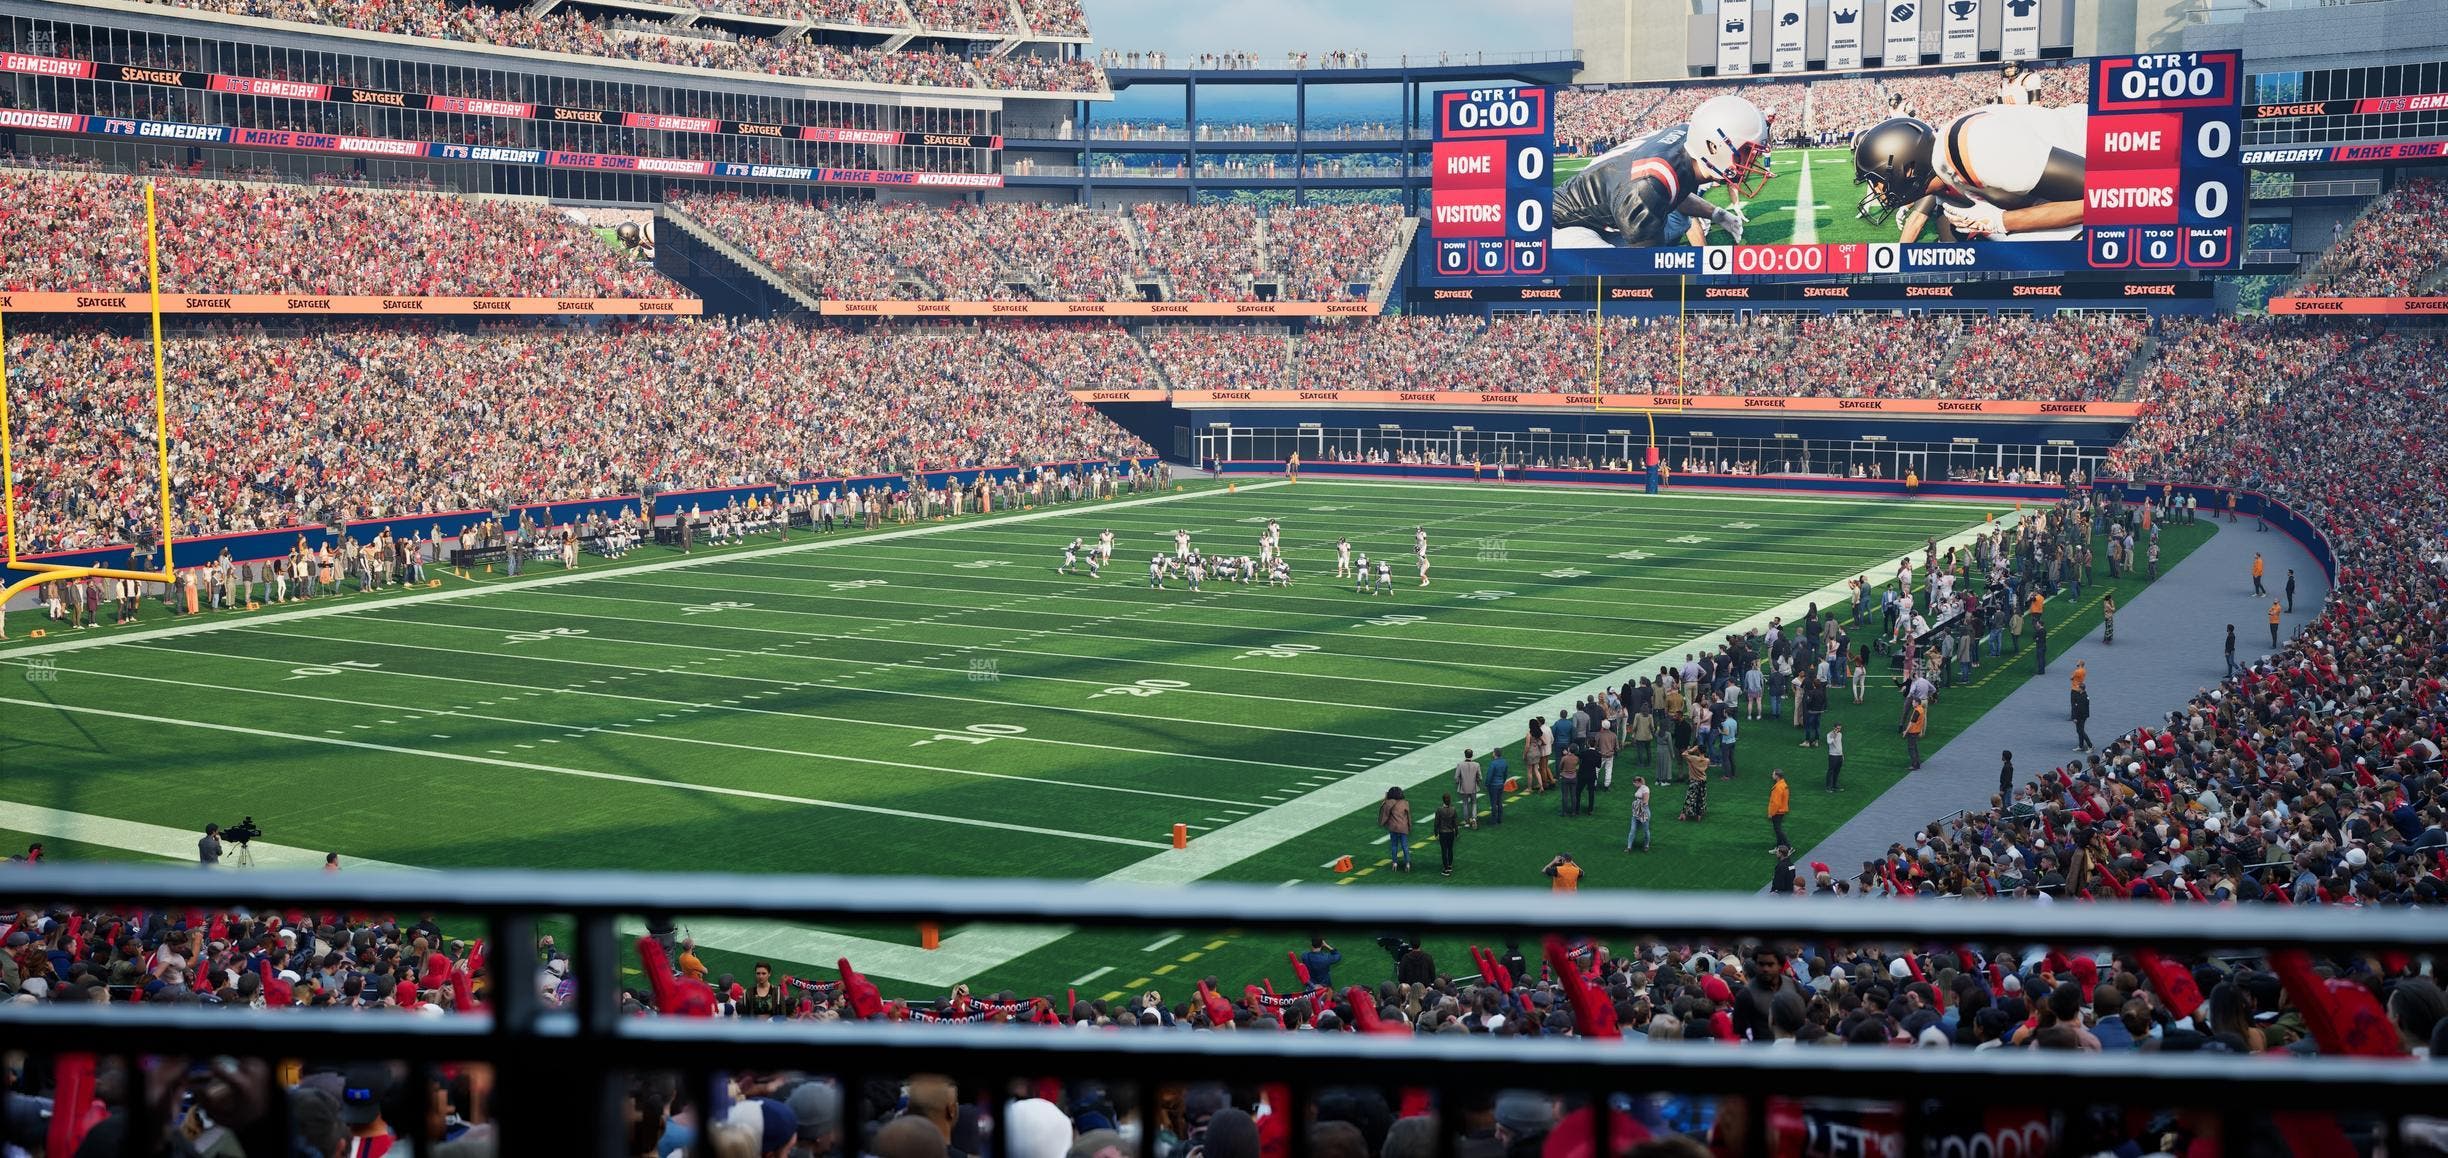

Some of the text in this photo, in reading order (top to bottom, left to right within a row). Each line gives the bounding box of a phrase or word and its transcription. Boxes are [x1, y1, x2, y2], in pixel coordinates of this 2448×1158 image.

[8, 56, 81, 75] GAMEDAY!
[2138, 54, 2196, 69] QTR 1
[122, 66, 182, 86] SEATGEEK
[2122, 68, 2213, 98] 0:00
[226, 78, 318, 98] IT'S GAMEDAY!
[1471, 88, 1515, 102] QTR 1
[353, 90, 404, 106] SEATGEEK
[2378, 98, 2406, 111] IT'S
[444, 99, 524, 115] IT'S GAMEDAY!
[1460, 101, 1528, 127] 0:00
[2258, 103, 2325, 117] SEATGEEK
[555, 108, 602, 123] SEATGEEK
[638, 115, 710, 130] IT'S GAMEDAY!
[104, 120, 222, 140] IT'S GAMEDAY!
[739, 124, 782, 136] SEATGEEK
[816, 129, 893, 142] IT'S GAMEDAY!
[245, 131, 416, 154] MAKE SOME NOOOOISE!!!
[924, 135, 970, 146] SEATGEEK
[2105, 121, 2230, 158] HOME 0
[442, 145, 539, 162] IT'S GAMEDAY!
[2242, 149, 2323, 164] GAMEDAY!
[2347, 146, 2392, 159] MAKE
[2399, 143, 2439, 156] SOME
[559, 154, 595, 165] MAKE
[601, 157, 634, 168] SOME
[1448, 147, 1543, 179] HOME 0
[726, 165, 812, 179] IT'S GAMEDAY!
[832, 171, 1000, 186] MAKE SOME NOOOOISE!!!
[2088, 182, 2228, 218] VISITORS 0
[1437, 200, 1542, 231] VISITORS 0
[1839, 244, 1856, 253] QRT
[2103, 242, 2118, 259] 0
[2151, 241, 2166, 258] 0
[2200, 240, 2216, 258] 0
[1449, 252, 1460, 267] 0
[1485, 252, 1497, 267] 0
[1522, 251, 1534, 266] 0
[1655, 252, 1695, 268] HOME
[1709, 249, 1726, 270] 0
[1738, 247, 1822, 271] 00:00
[1844, 254, 1850, 270] 1
[1875, 247, 1893, 268] 0
[1908, 248, 1975, 265] VISITORS
[1434, 290, 1472, 298] SEATGEEK
[1522, 289, 1561, 298] SEATGEEK
[1612, 288, 1653, 298] SEATGEEK
[1706, 288, 1749, 297] SEATGEEK
[1804, 287, 1848, 297] SEATGEEK
[1906, 286, 1952, 296] SEATGEEK
[2013, 286, 2061, 296] SEATGEEK
[2124, 285, 2175, 295] SEATGEEK
[77, 297, 126, 308] SEATGEEK
[186, 298, 230, 308] SEATGEEK
[288, 299, 330, 309] SEATGEEK
[383, 300, 422, 309] SEATGEEK
[473, 301, 511, 310] SEATGEEK
[558, 302, 594, 310] SEATGEEK
[640, 302, 673, 310] SEATGEEK
[2405, 302, 2448, 310] SEATGEEK
[1654, 398, 1692, 406] SEATGEEK
[1745, 399, 1785, 407] SEATGEEK
[1840, 401, 1881, 409] SEATGEEK
[1938, 402, 1982, 410] SEATGEEK
[2041, 404, 2086, 412] SEATGEEK
[1104, 679, 1191, 698] 20
[933, 724, 1028, 745] 10
[1260, 996, 1278, 1006] LET'S
